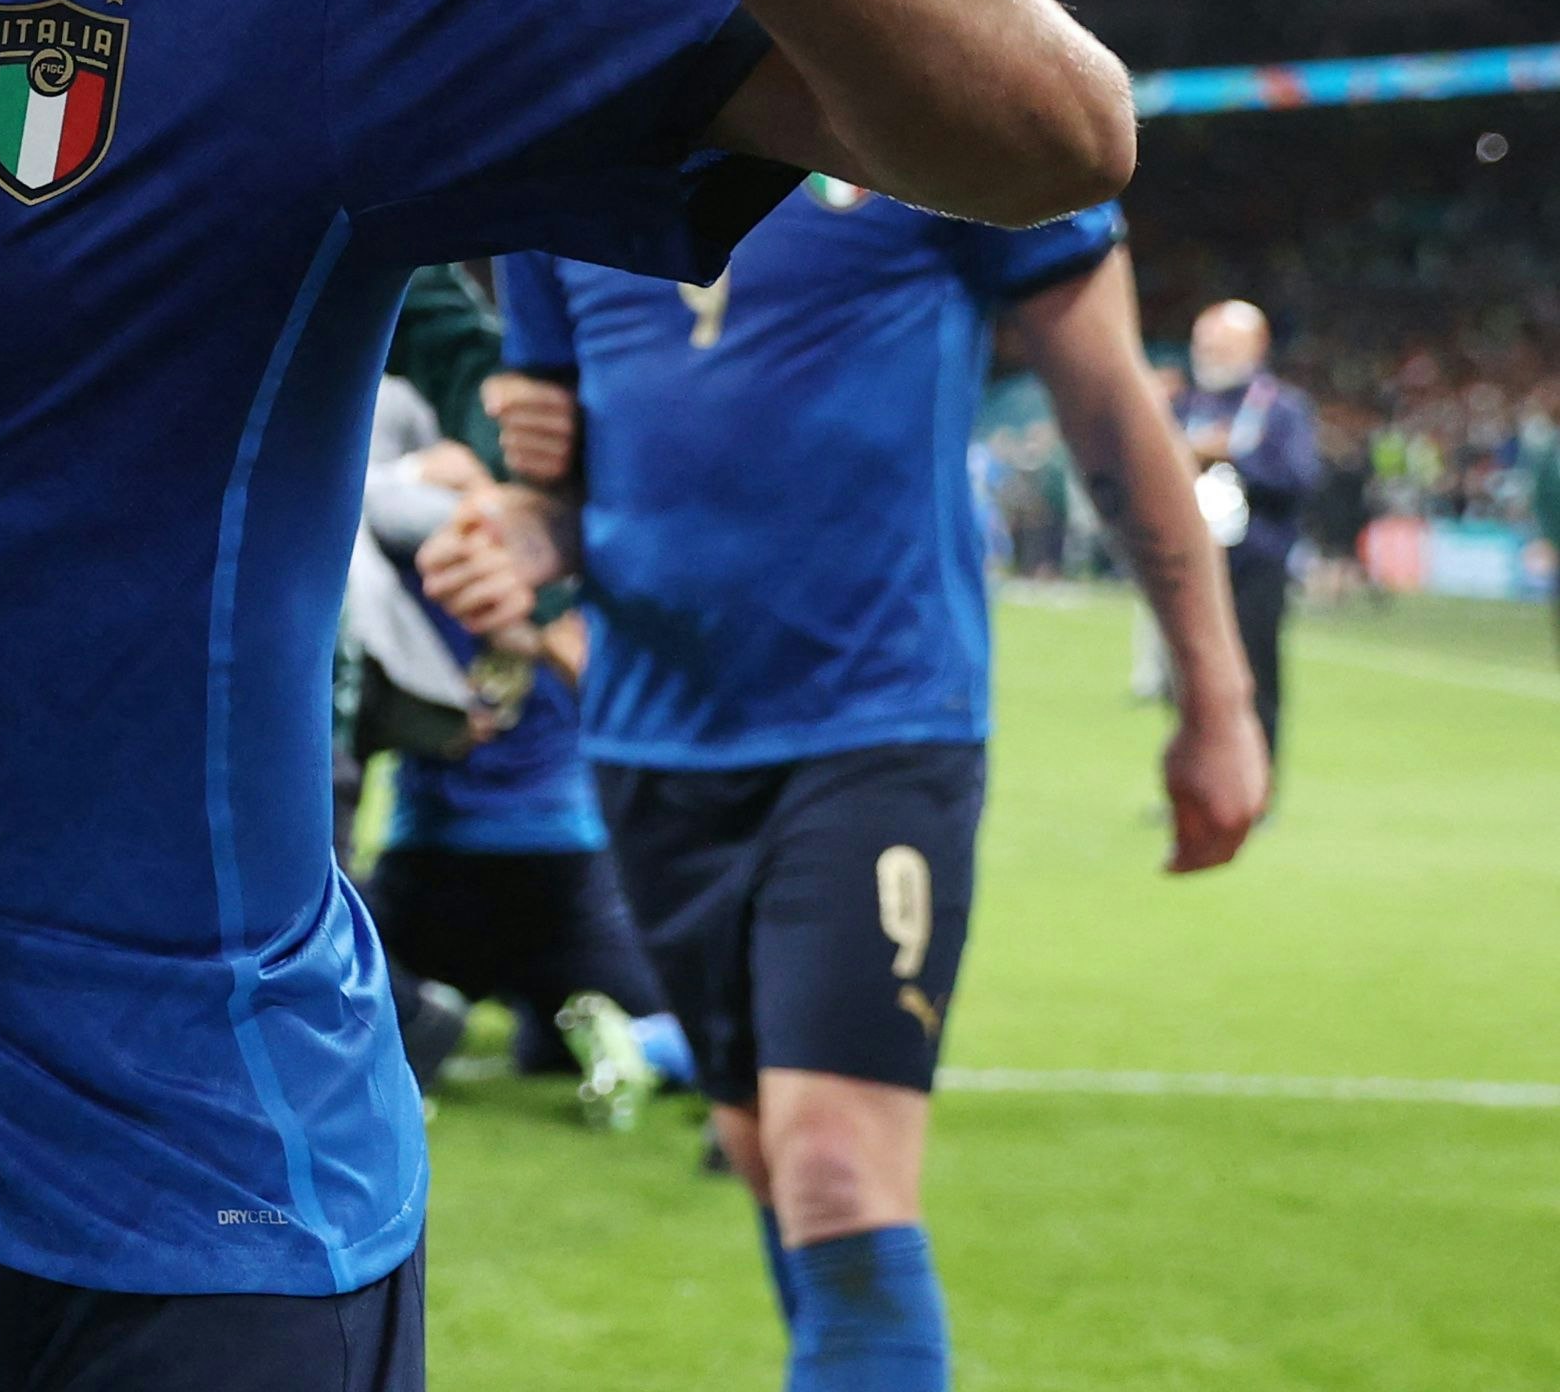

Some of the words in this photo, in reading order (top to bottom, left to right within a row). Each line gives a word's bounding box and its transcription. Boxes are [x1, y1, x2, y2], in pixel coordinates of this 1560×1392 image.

[1, 18, 112, 56] ITALIA
[41, 63, 64, 74] FIGC
[876, 844, 933, 980] 9
[217, 1209, 288, 1225] DRYCELL
